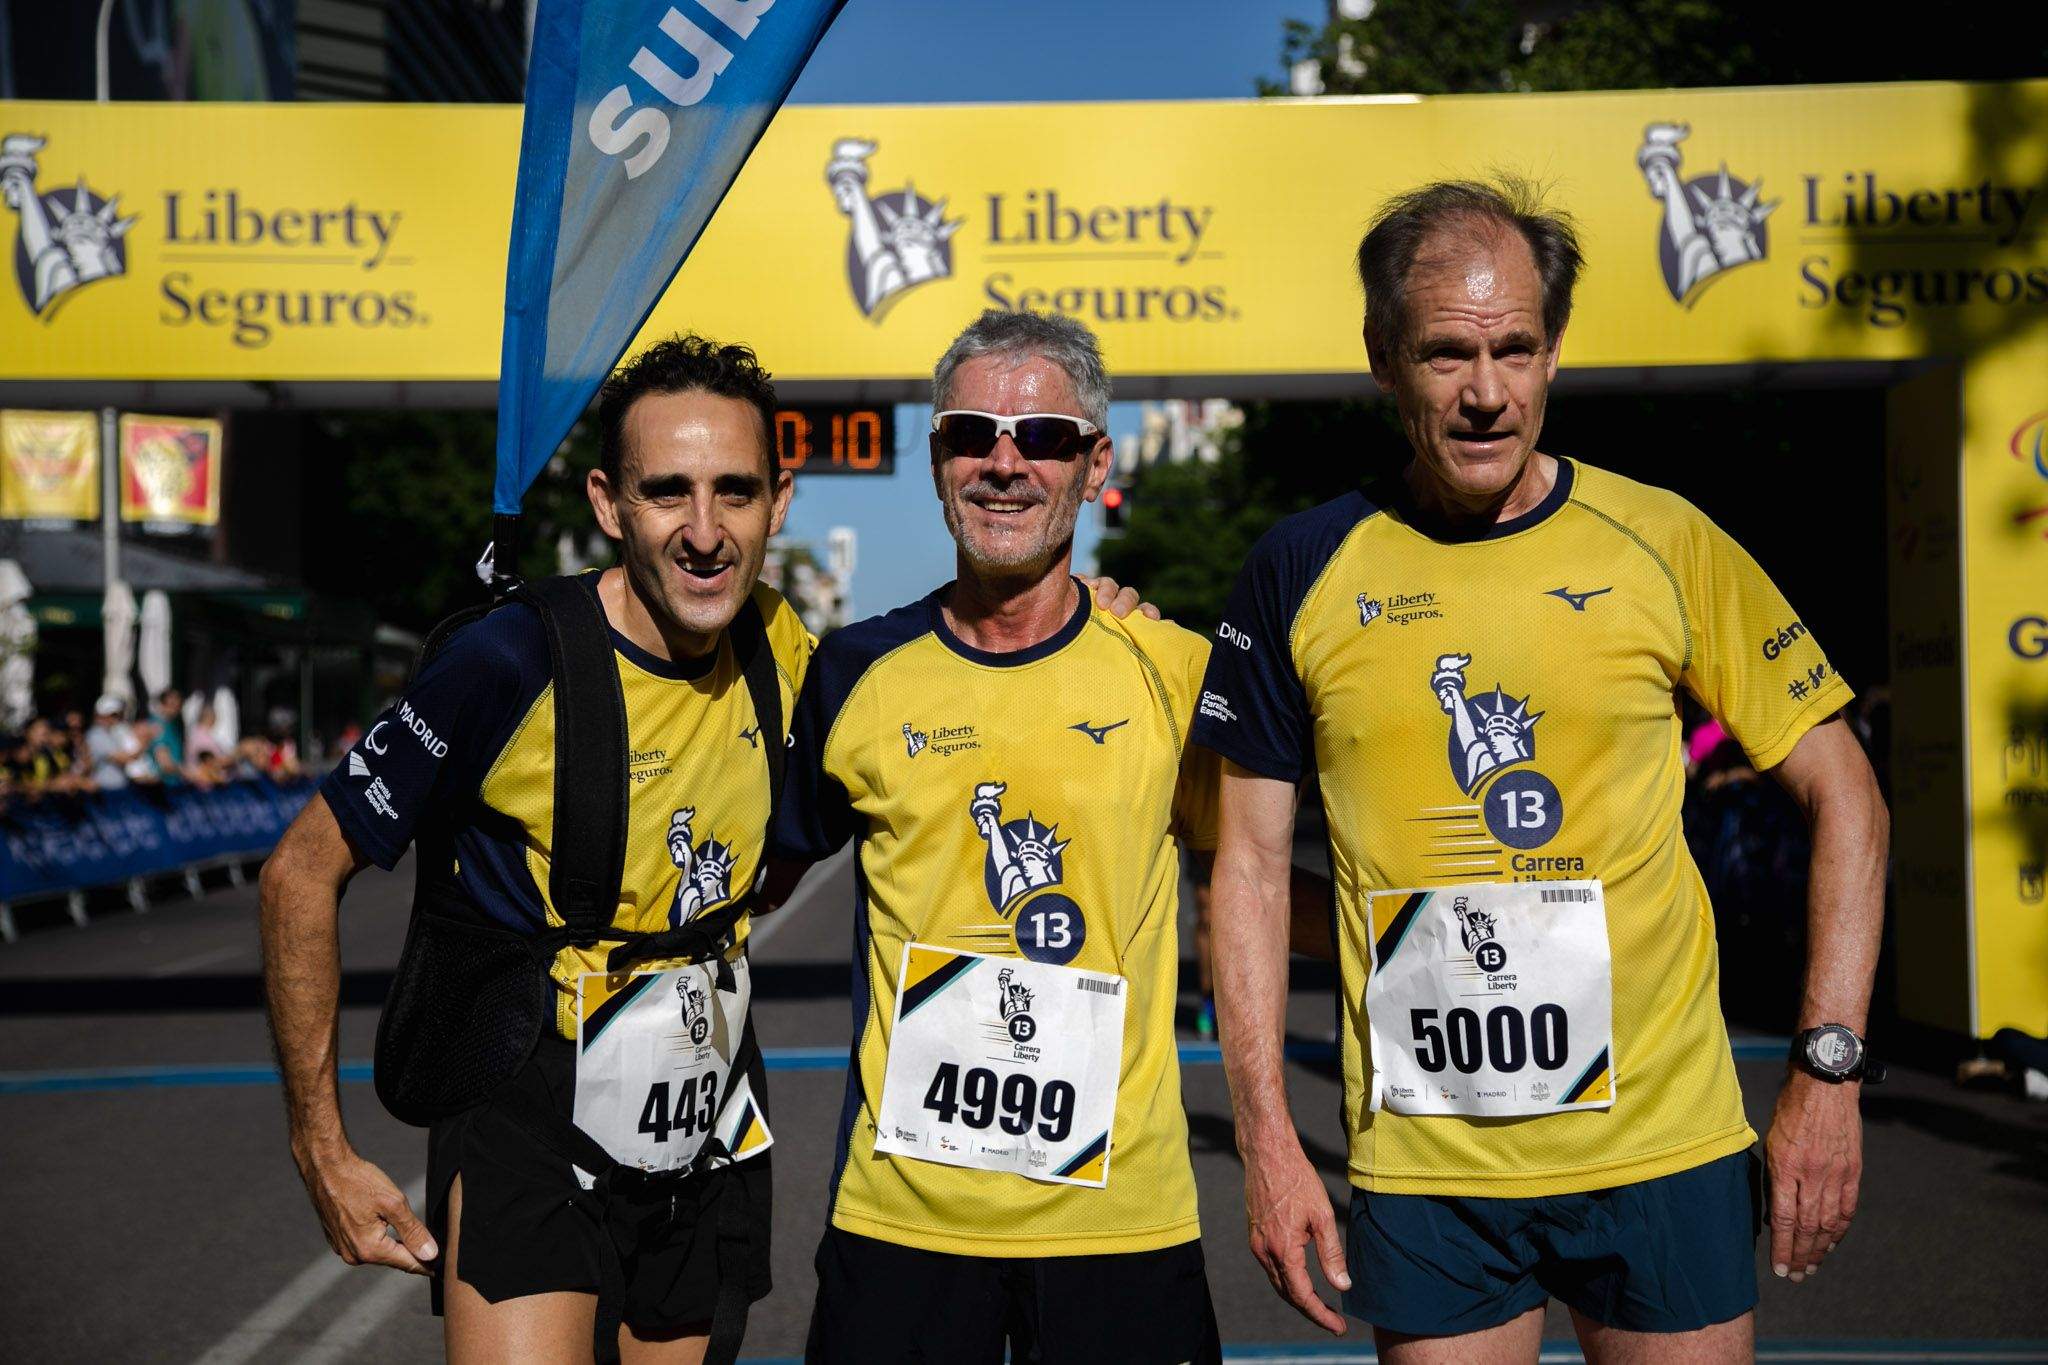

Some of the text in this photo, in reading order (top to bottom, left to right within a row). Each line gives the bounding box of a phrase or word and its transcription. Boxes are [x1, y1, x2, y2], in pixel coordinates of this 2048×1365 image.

[1802, 170, 2039, 246] Liberty
[161, 190, 401, 268] Liberty
[986, 190, 1213, 265] Liberty
[160, 272, 428, 347] Seguros.
[1388, 592, 1436, 606] Liberty
[1216, 622, 1252, 650] DRID
[400, 701, 448, 758] MADRID
[932, 724, 975, 739] Liberty
[630, 750, 666, 763] iberty
[630, 767, 672, 783] eguros.
[1500, 790, 1546, 829] 13
[1512, 854, 1584, 872] Carrera
[1031, 912, 1072, 948] 13
[1482, 949, 1500, 965] 13
[1487, 973, 1517, 982] Carrera
[1488, 982, 1517, 991] Liberty
[694, 1023, 705, 1038] 13
[1014, 1020, 1031, 1037] 13
[1410, 1003, 1568, 1074] 5000
[1013, 1051, 1040, 1062] Liberty
[1014, 1043, 1041, 1054] Carrera
[638, 1070, 718, 1143] 443
[923, 1062, 1076, 1143] 4999
